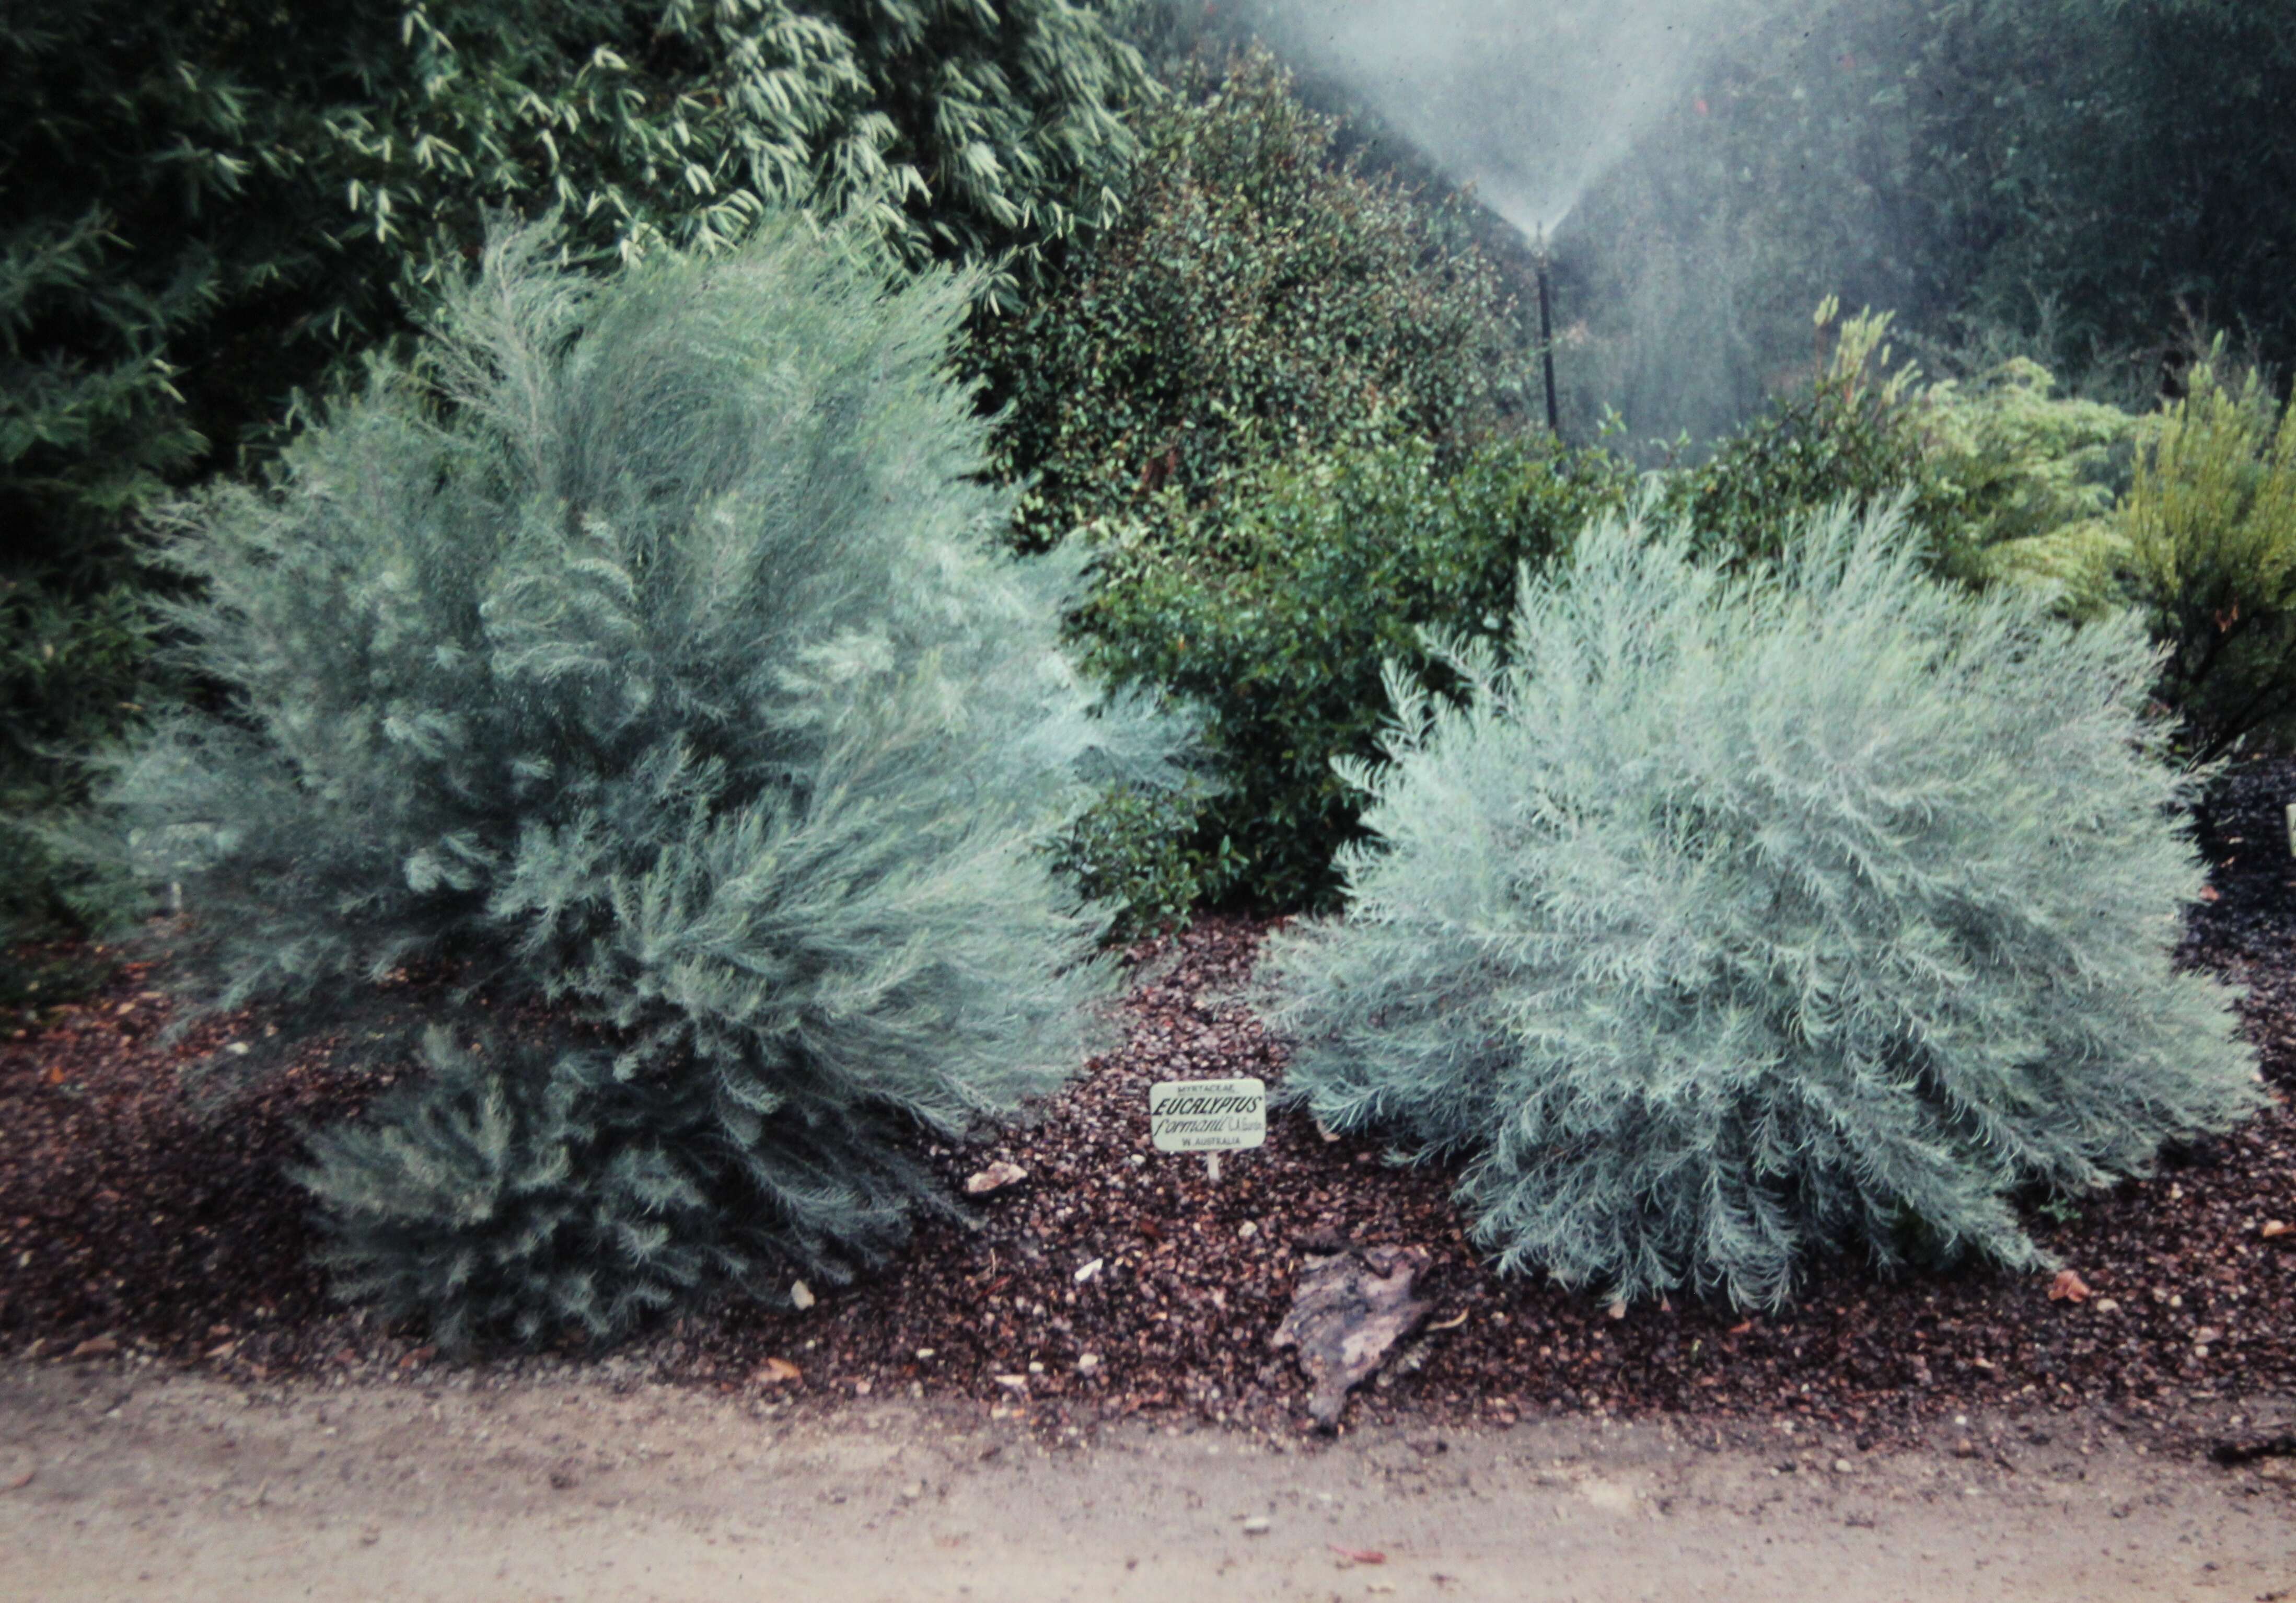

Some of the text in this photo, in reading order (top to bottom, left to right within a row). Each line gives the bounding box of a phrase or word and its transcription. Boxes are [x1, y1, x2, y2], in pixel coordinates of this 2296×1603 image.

[1178, 1084, 1234, 1093] MYRTACEAE
[1152, 1096, 1262, 1115] EUCALYPTUS
[1195, 1137, 1240, 1146] AUSTRALIA
